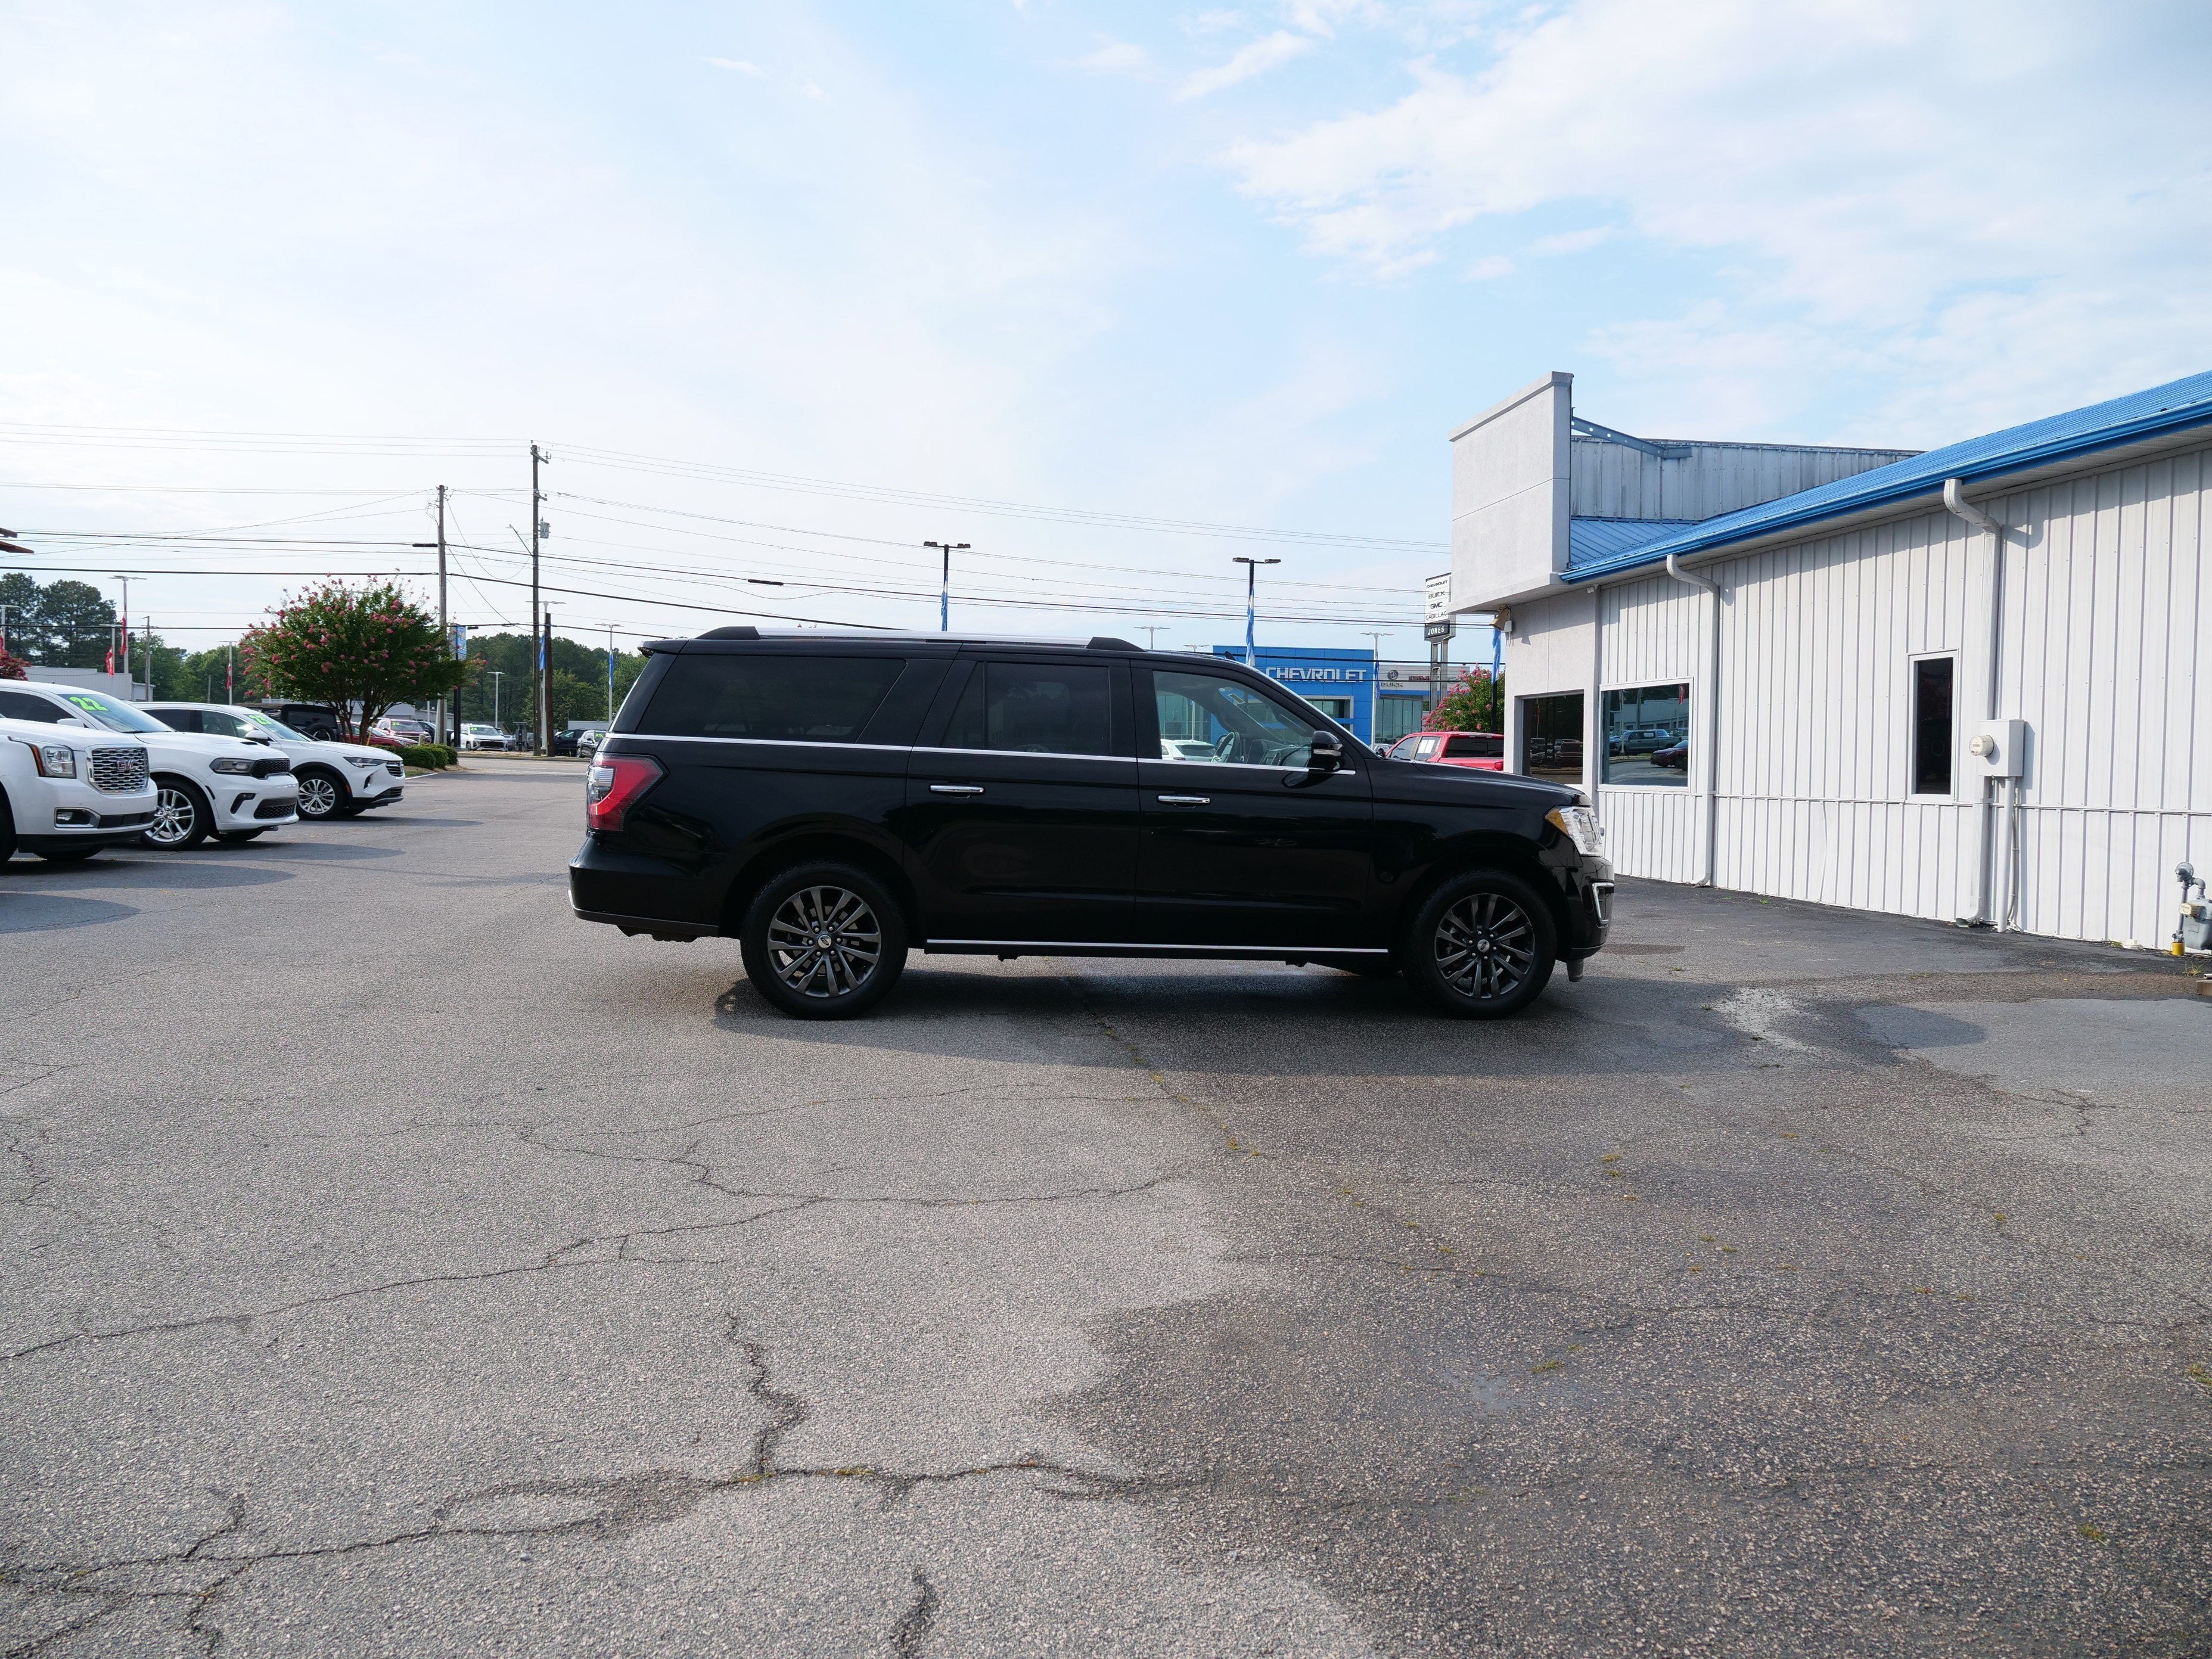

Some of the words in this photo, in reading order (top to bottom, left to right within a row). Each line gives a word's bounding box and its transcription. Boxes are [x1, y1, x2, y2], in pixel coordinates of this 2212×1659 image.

[1426, 580, 1448, 589] CHEVROLET
[1428, 591, 1445, 599] BUICK
[1425, 611, 1447, 620] CADILLAC
[1427, 626, 1444, 635] JONES
[1266, 667, 1366, 683] CHEVROLET
[69, 697, 110, 711] 22
